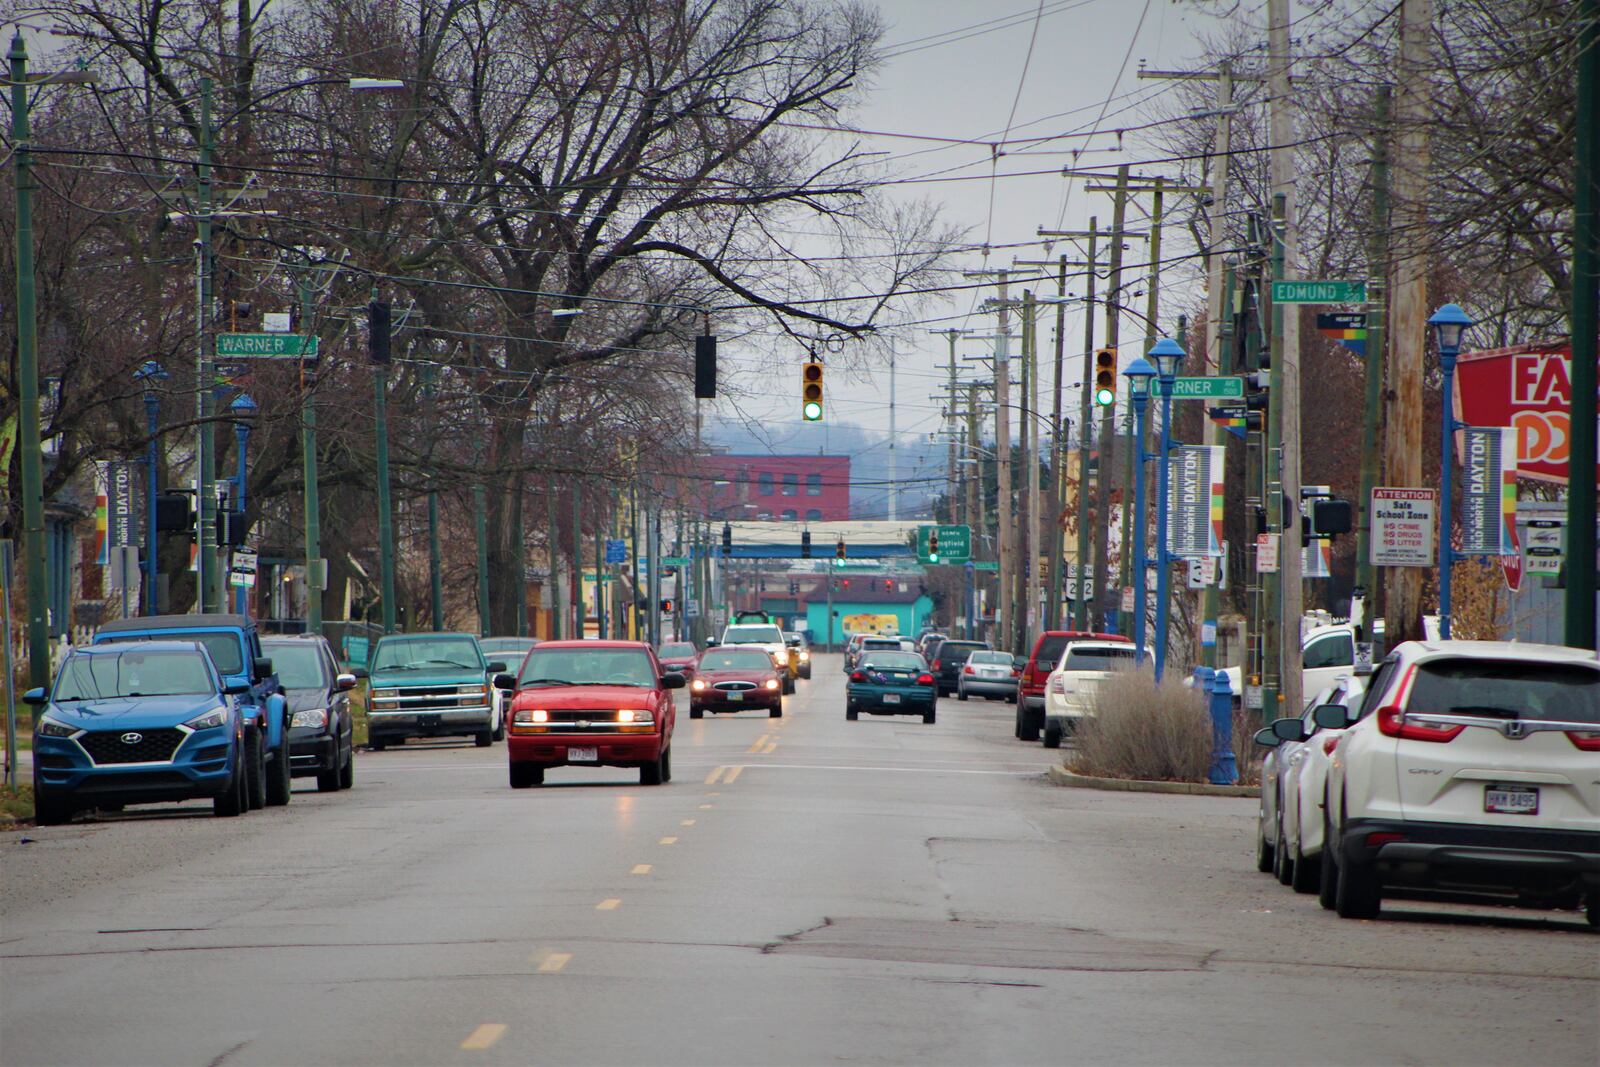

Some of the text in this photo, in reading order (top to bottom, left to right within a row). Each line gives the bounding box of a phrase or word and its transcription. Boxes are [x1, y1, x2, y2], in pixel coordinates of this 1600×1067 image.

[1277, 284, 1337, 299] EDMUND
[222, 338, 284, 352] WARNER
[1184, 450, 1197, 503] DAYTON
[116, 465, 128, 515] DAYTON
[1375, 490, 1432, 499] ATTENTION
[1471, 432, 1485, 549] OLD NORTH DAYTON
[1393, 501, 1412, 509] Safe
[1187, 506, 1195, 534] NORTH
[1376, 510, 1428, 519] School Zone
[1070, 565, 1093, 575] STH
[1069, 582, 1092, 595] 22
